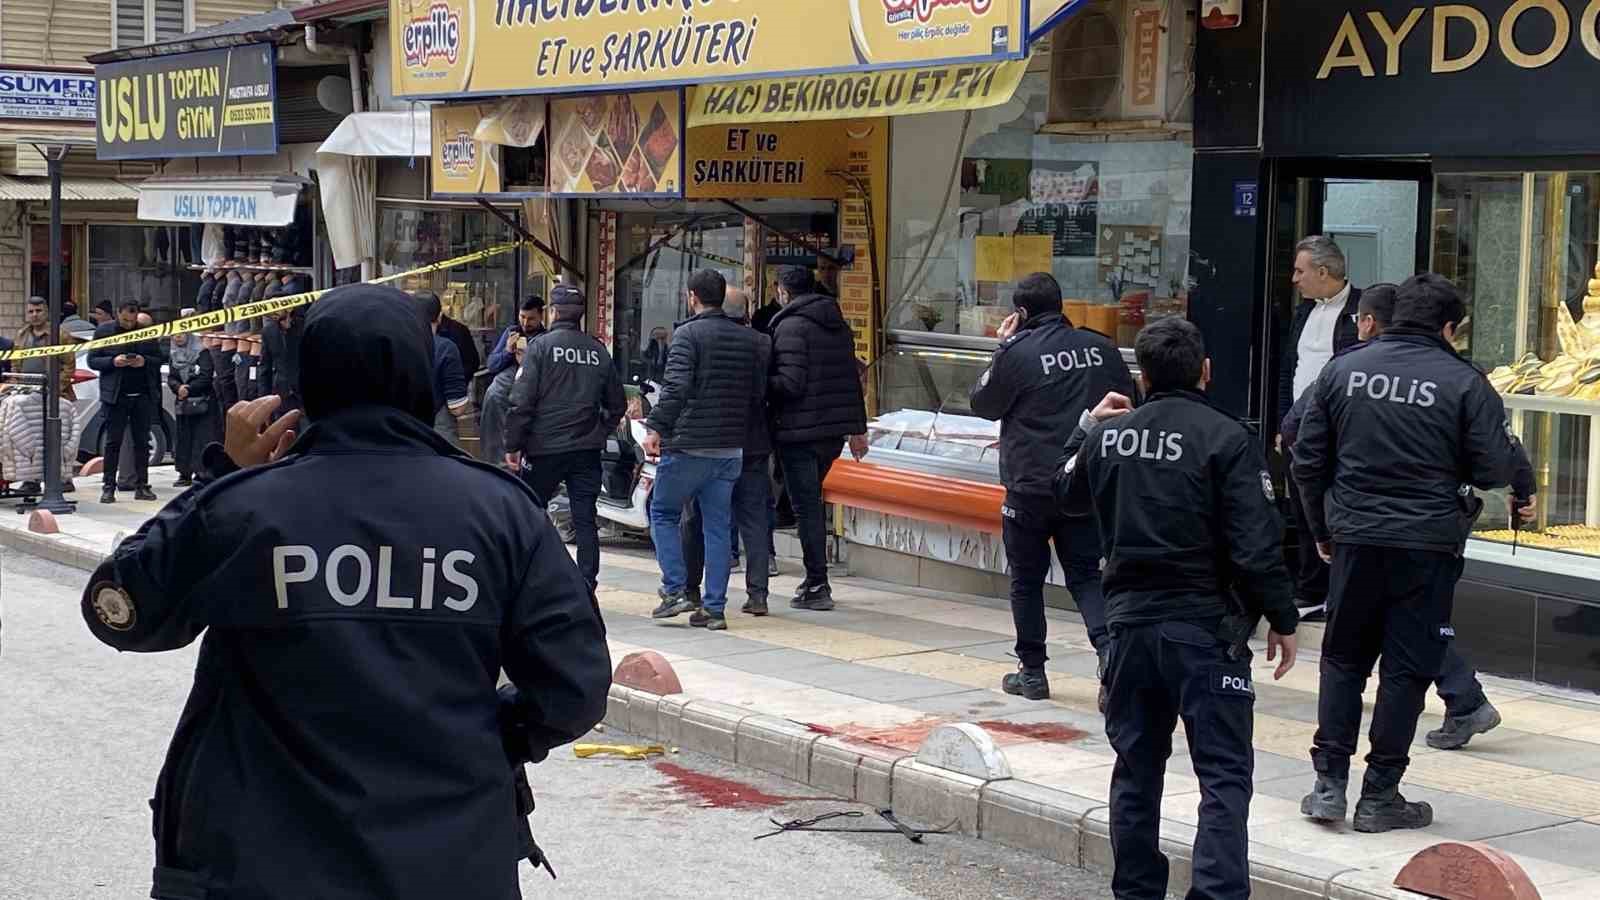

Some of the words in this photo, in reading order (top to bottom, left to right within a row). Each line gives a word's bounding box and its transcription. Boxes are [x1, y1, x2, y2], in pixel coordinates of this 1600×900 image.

[405, 10, 458, 60] erpiliç
[536, 38, 567, 76] ET
[569, 46, 595, 75] ve
[600, 16, 757, 78] ŞARKÜTERİ
[1137, 20, 1153, 100] VESTEL
[100, 71, 166, 143] USLU
[168, 66, 220, 100] TOPTAN
[703, 84, 762, 115] HACI
[907, 69, 948, 104] ET
[727, 128, 750, 151] ET
[756, 133, 778, 152] ve
[693, 156, 804, 185] ŞARKÜTERİ
[174, 195, 204, 217] USLU
[207, 196, 257, 220] TOPTAN
[1242, 192, 1253, 205] 12
[1222, 675, 1251, 692] POL
